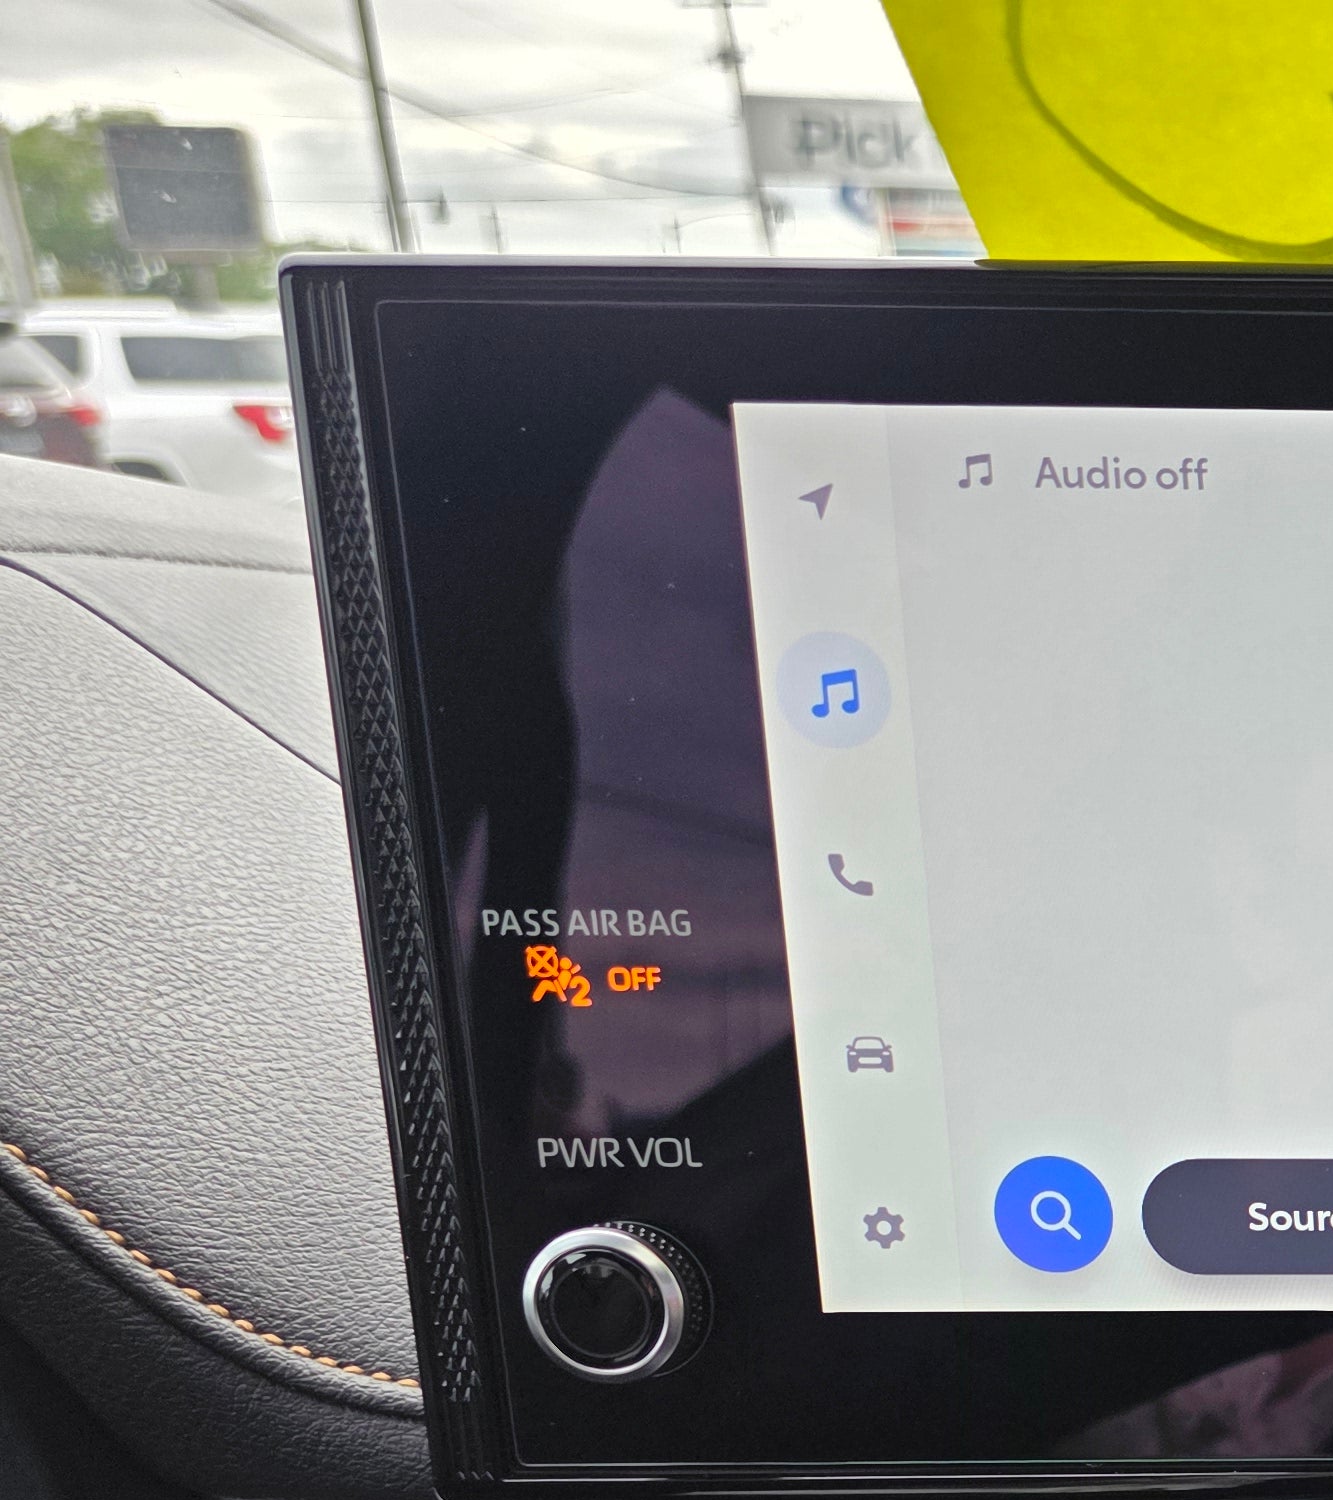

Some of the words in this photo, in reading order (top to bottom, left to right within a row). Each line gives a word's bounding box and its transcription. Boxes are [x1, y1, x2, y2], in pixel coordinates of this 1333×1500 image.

[1035, 456, 1148, 489] Audio
[1155, 457, 1209, 490] off
[481, 908, 560, 937] PASS
[567, 908, 622, 937] AIR
[627, 908, 692, 937] BAG
[607, 966, 662, 992] OFF
[537, 1137, 625, 1168] PWR
[627, 1137, 703, 1168] VOL
